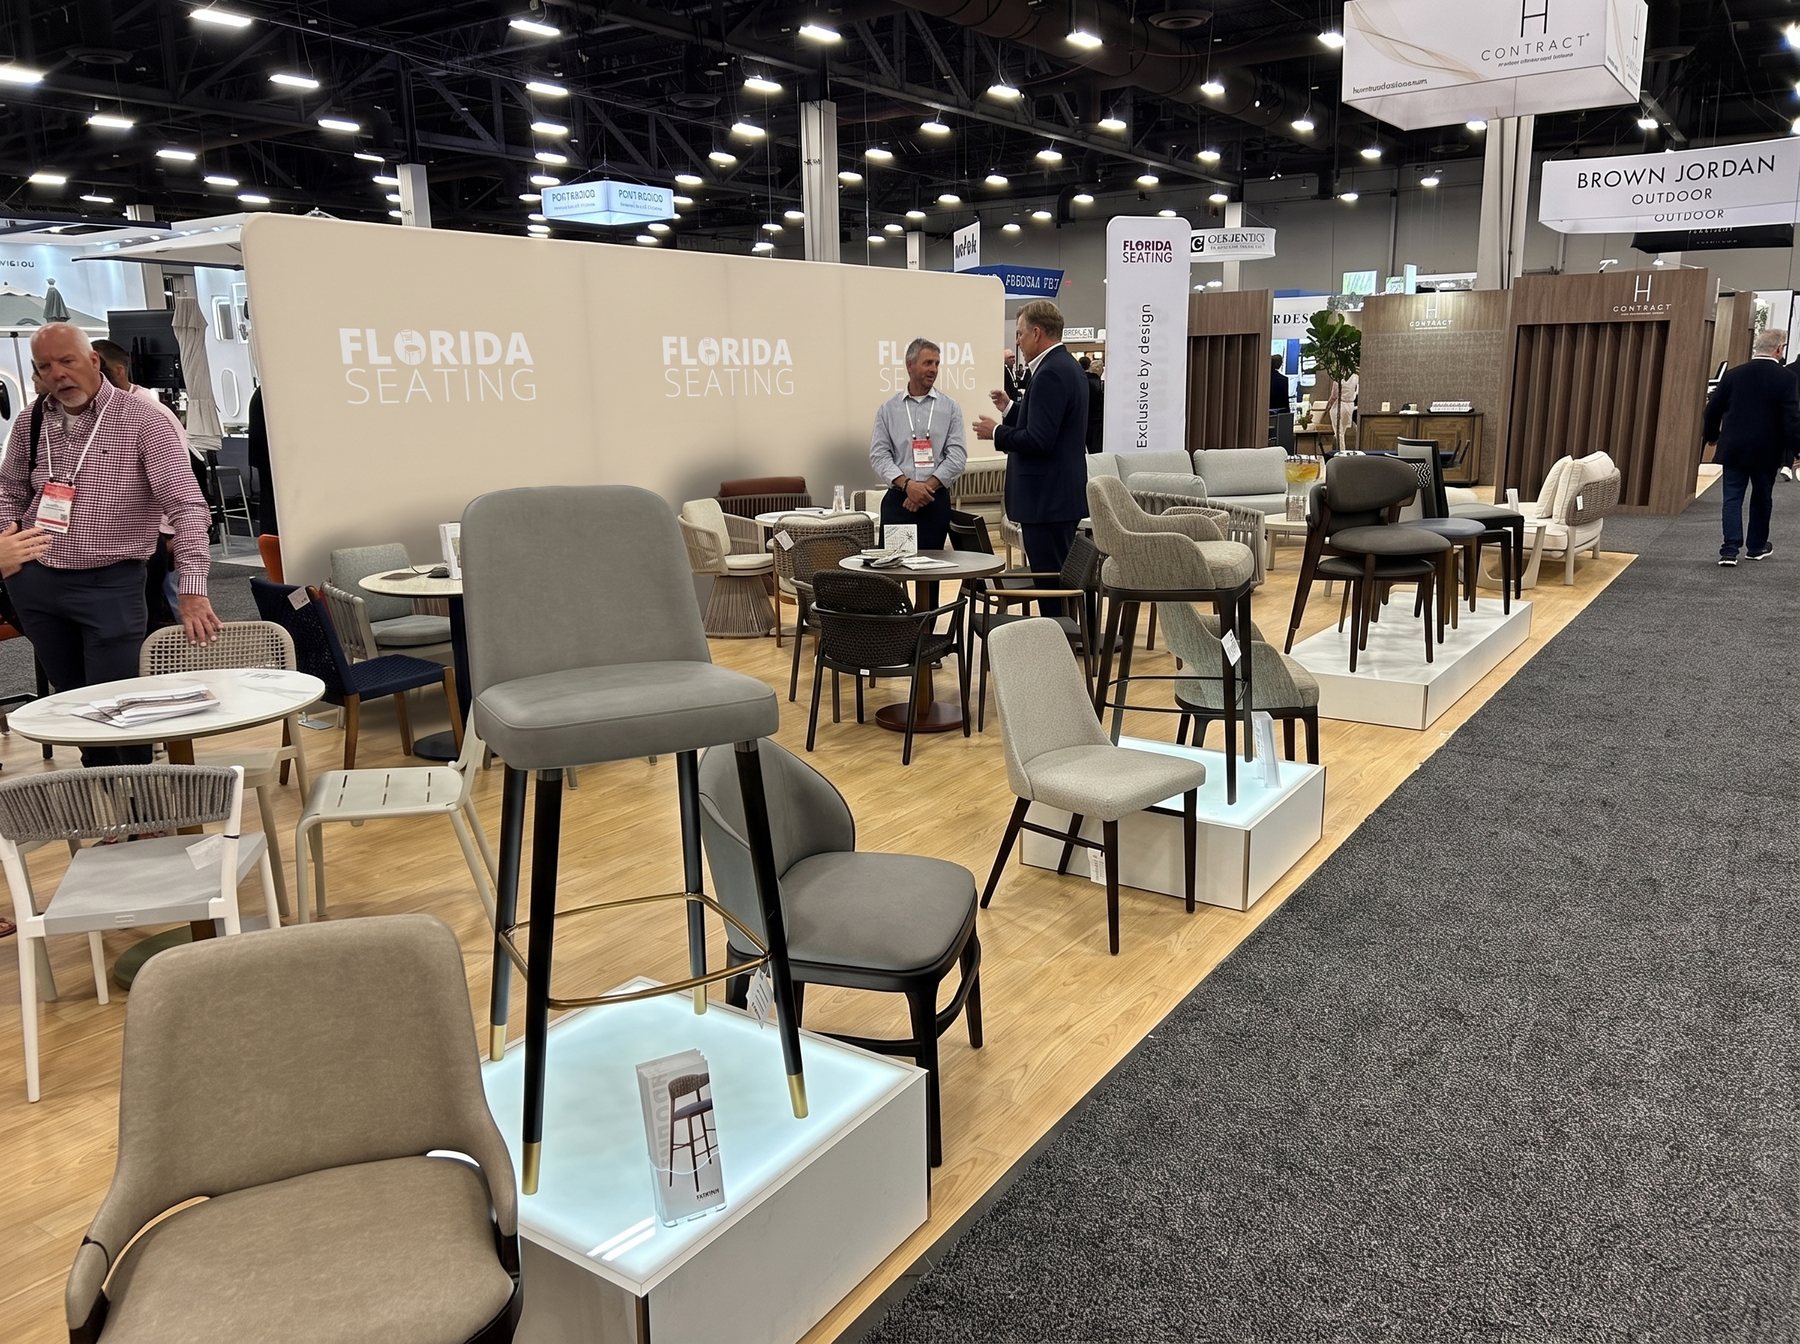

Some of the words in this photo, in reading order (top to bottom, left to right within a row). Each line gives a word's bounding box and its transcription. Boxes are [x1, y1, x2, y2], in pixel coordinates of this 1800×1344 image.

[1520, 0, 1549, 38] H
[1481, 34, 1585, 61] CONTRACT
[1577, 167, 1665, 189] BROWN
[1674, 154, 1776, 183] JORDAN
[1631, 188, 1713, 205] OUTDOOR
[1122, 251, 1173, 263] SEATING
[1123, 240, 1172, 251] FLORIDA
[1634, 274, 1652, 302] H
[1613, 303, 1672, 313] CONTRACT
[1138, 304, 1154, 354] design
[339, 327, 535, 366] FLORIDA
[662, 335, 793, 366] FLORIDA
[878, 340, 976, 366] FLIDA
[664, 367, 795, 398] SEATING
[879, 366, 977, 392] SEING
[1137, 360, 1153, 377] by
[345, 367, 537, 405] SEATING
[1136, 382, 1149, 449] Exclusive
